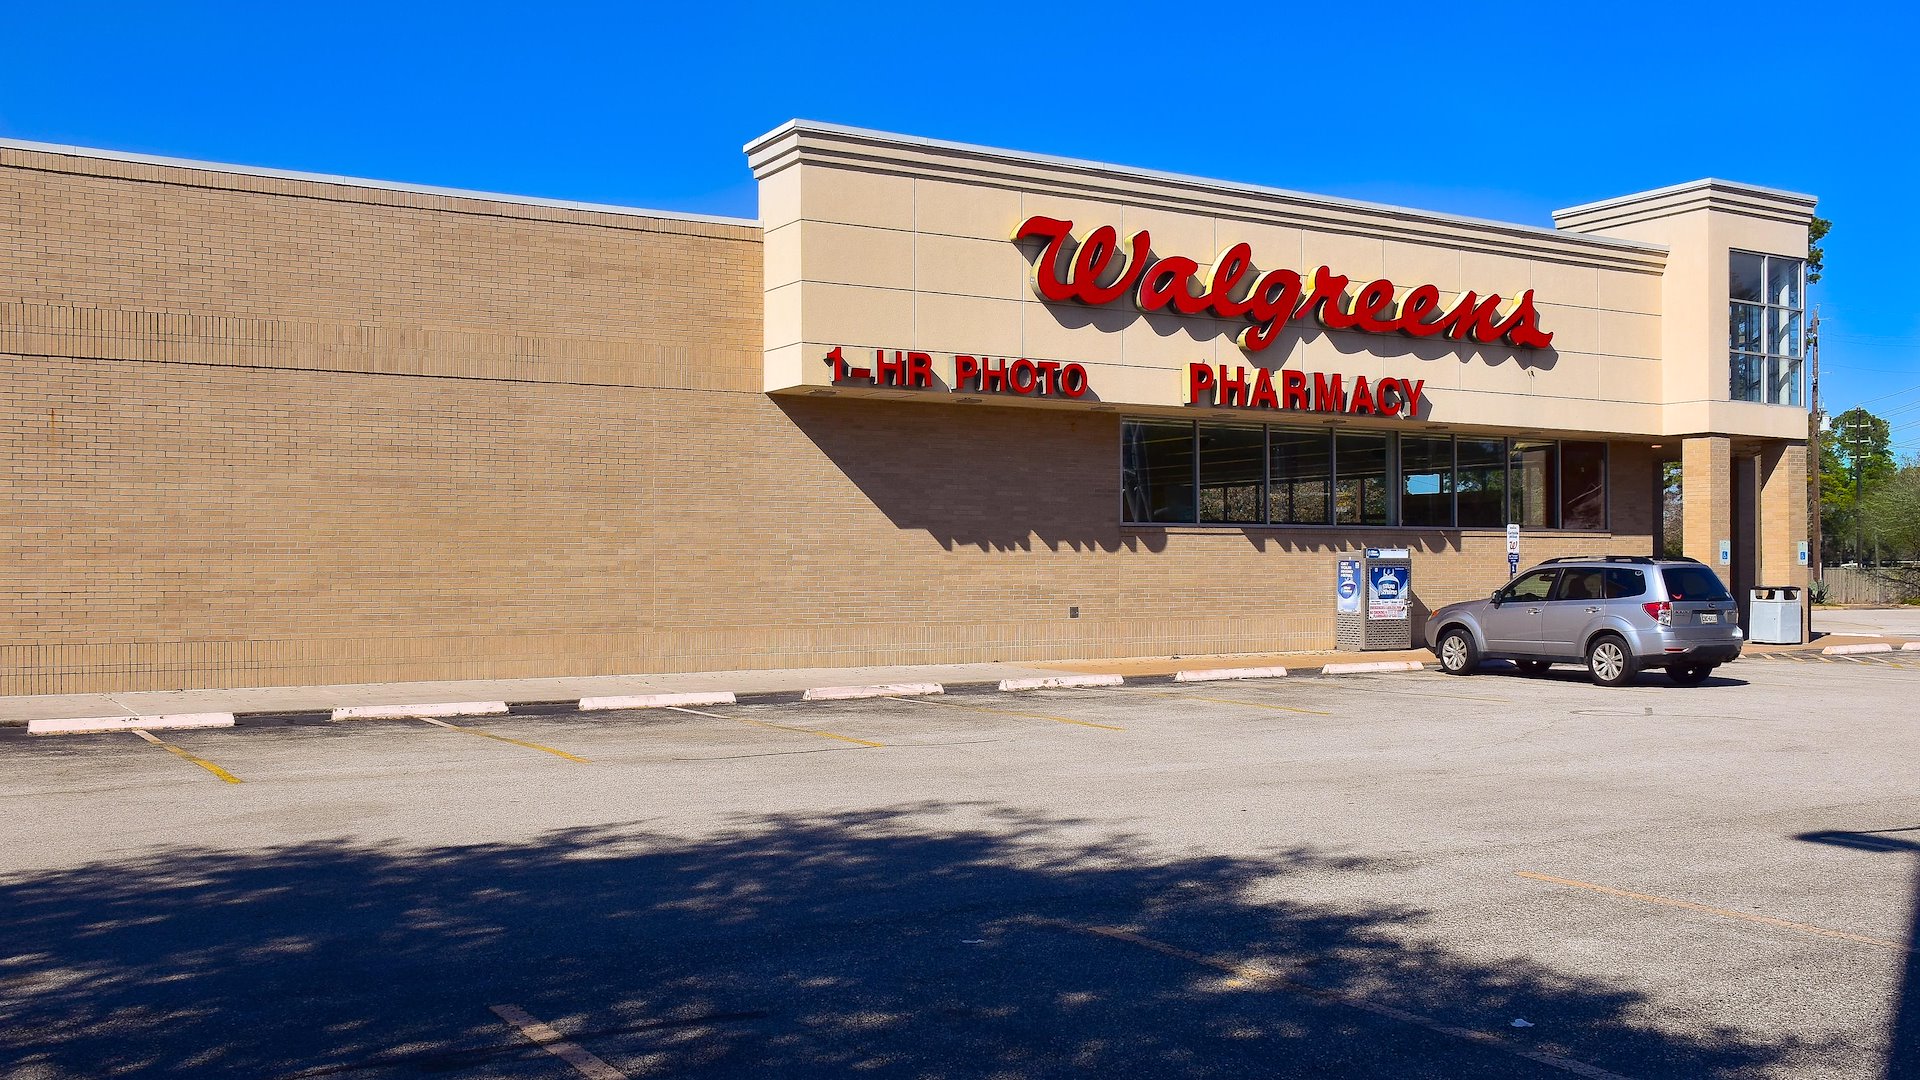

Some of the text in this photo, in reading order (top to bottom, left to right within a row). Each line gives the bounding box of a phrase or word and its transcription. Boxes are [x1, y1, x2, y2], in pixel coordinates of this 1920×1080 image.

[1011, 215, 1554, 352] Walgreens
[826, 346, 1088, 398] 1-HR PHOTO
[1186, 362, 1426, 417] PHARMACY
